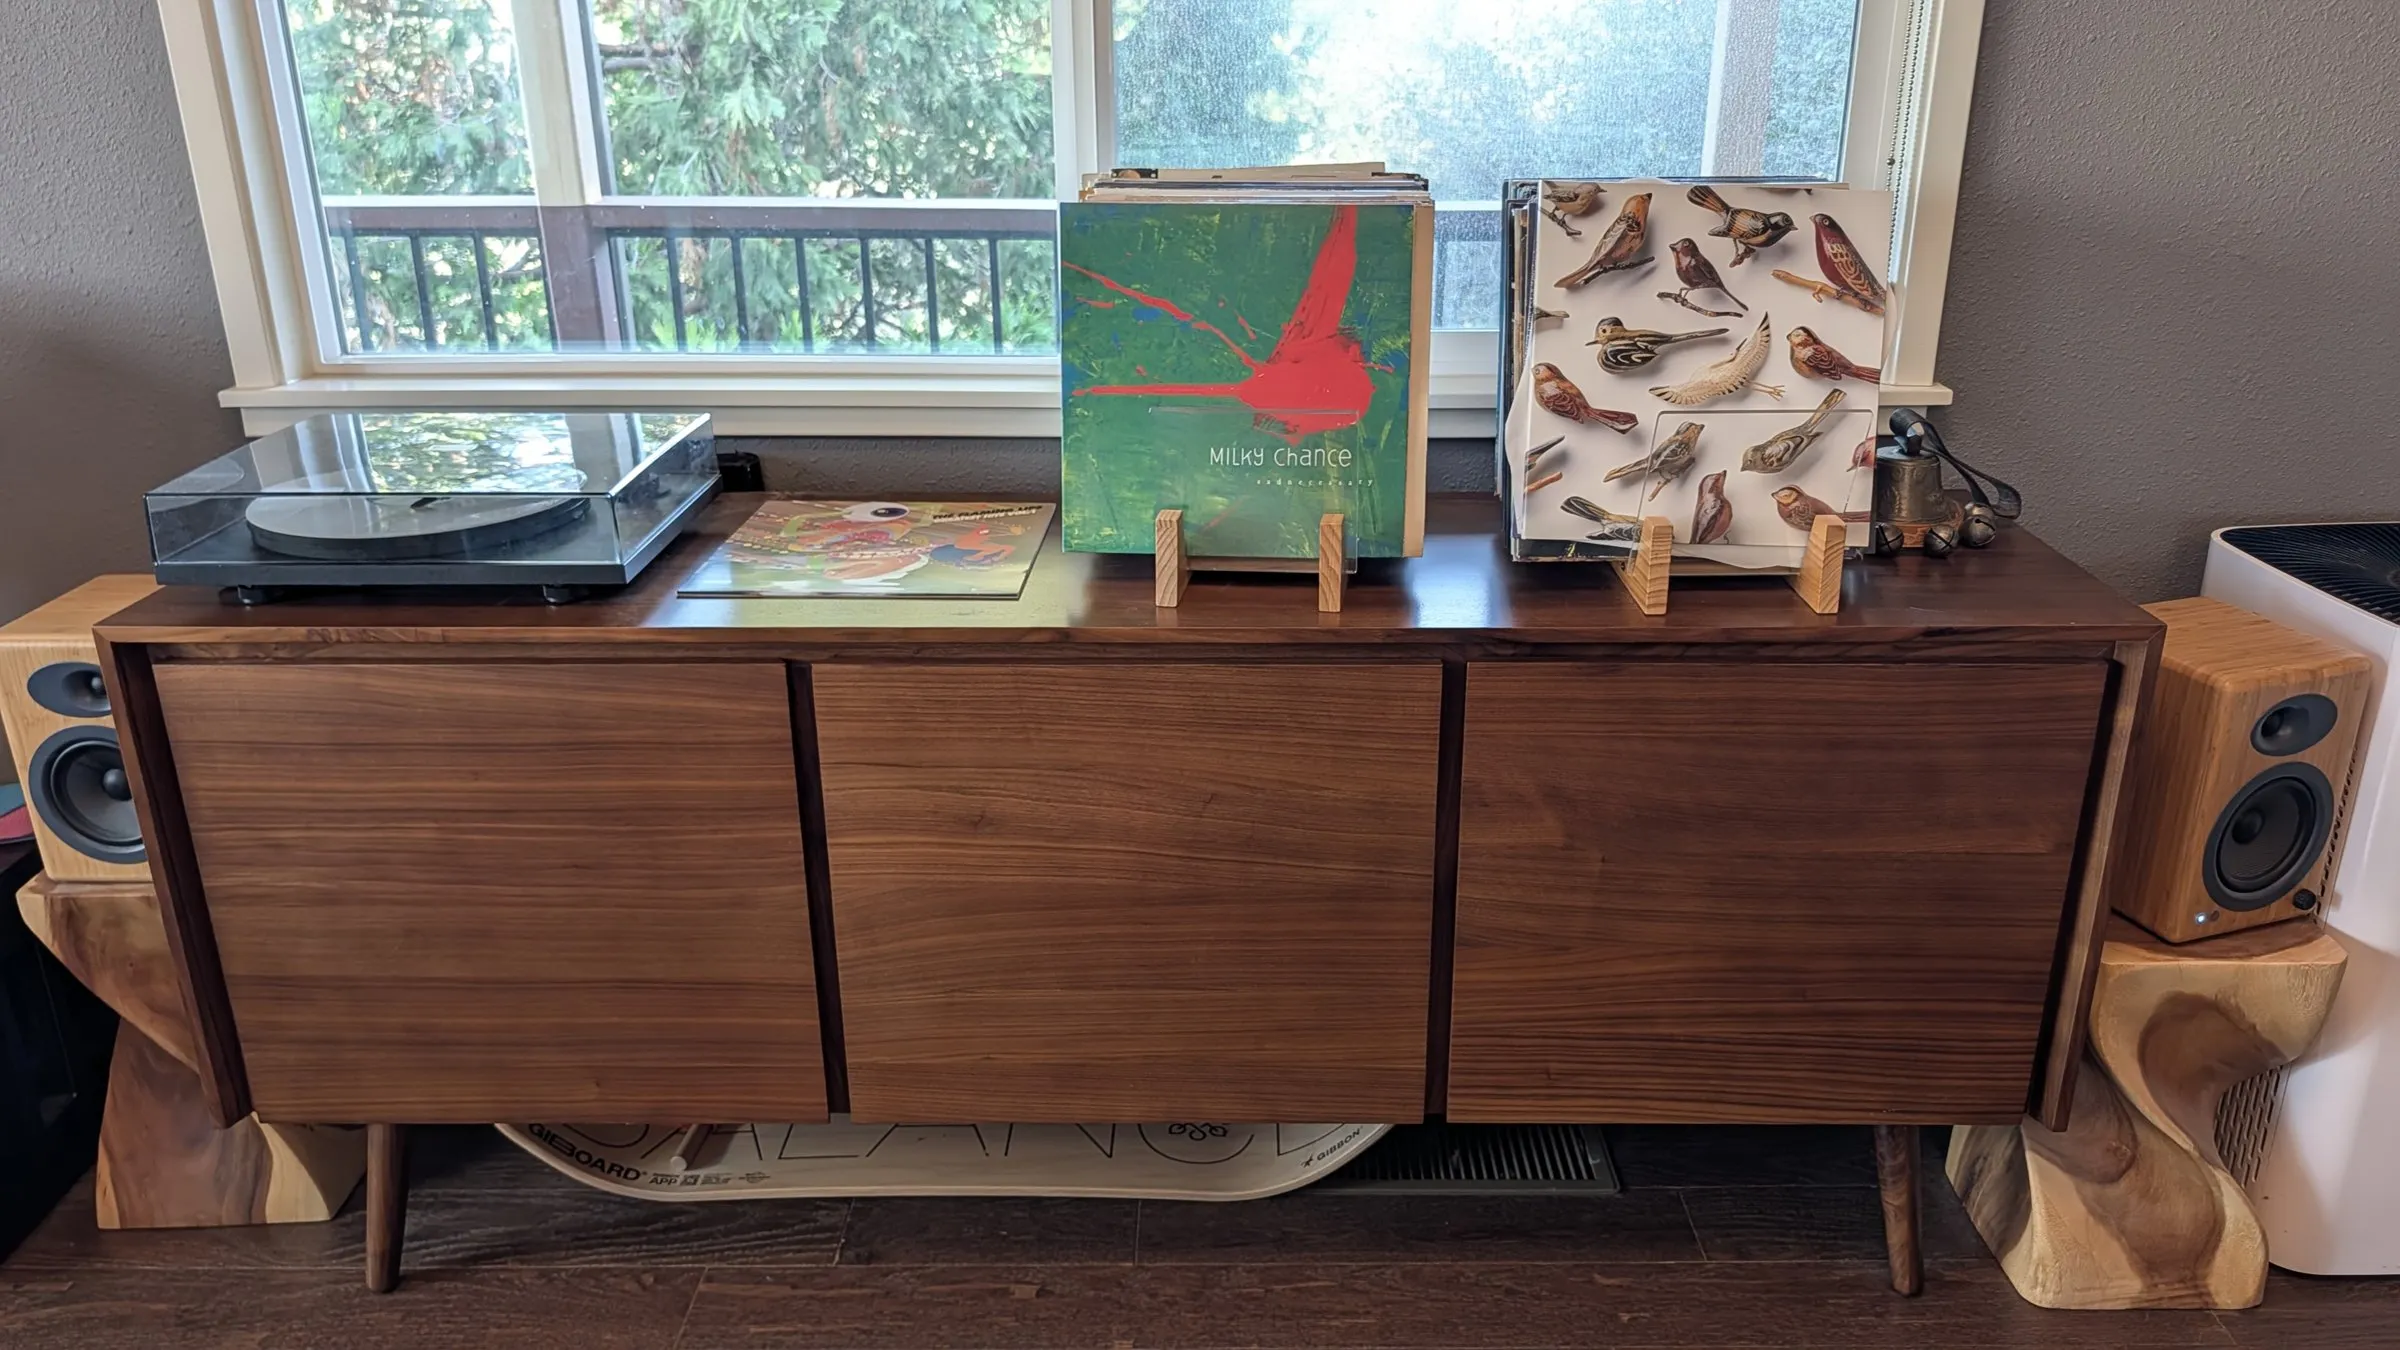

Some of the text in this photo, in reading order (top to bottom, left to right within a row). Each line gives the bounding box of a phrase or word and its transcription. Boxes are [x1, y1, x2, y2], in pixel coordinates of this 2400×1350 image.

[958, 507, 1014, 517] FLAMING
[1317, 1128, 1360, 1161] GIBBON
[649, 1176, 677, 1185] APP
